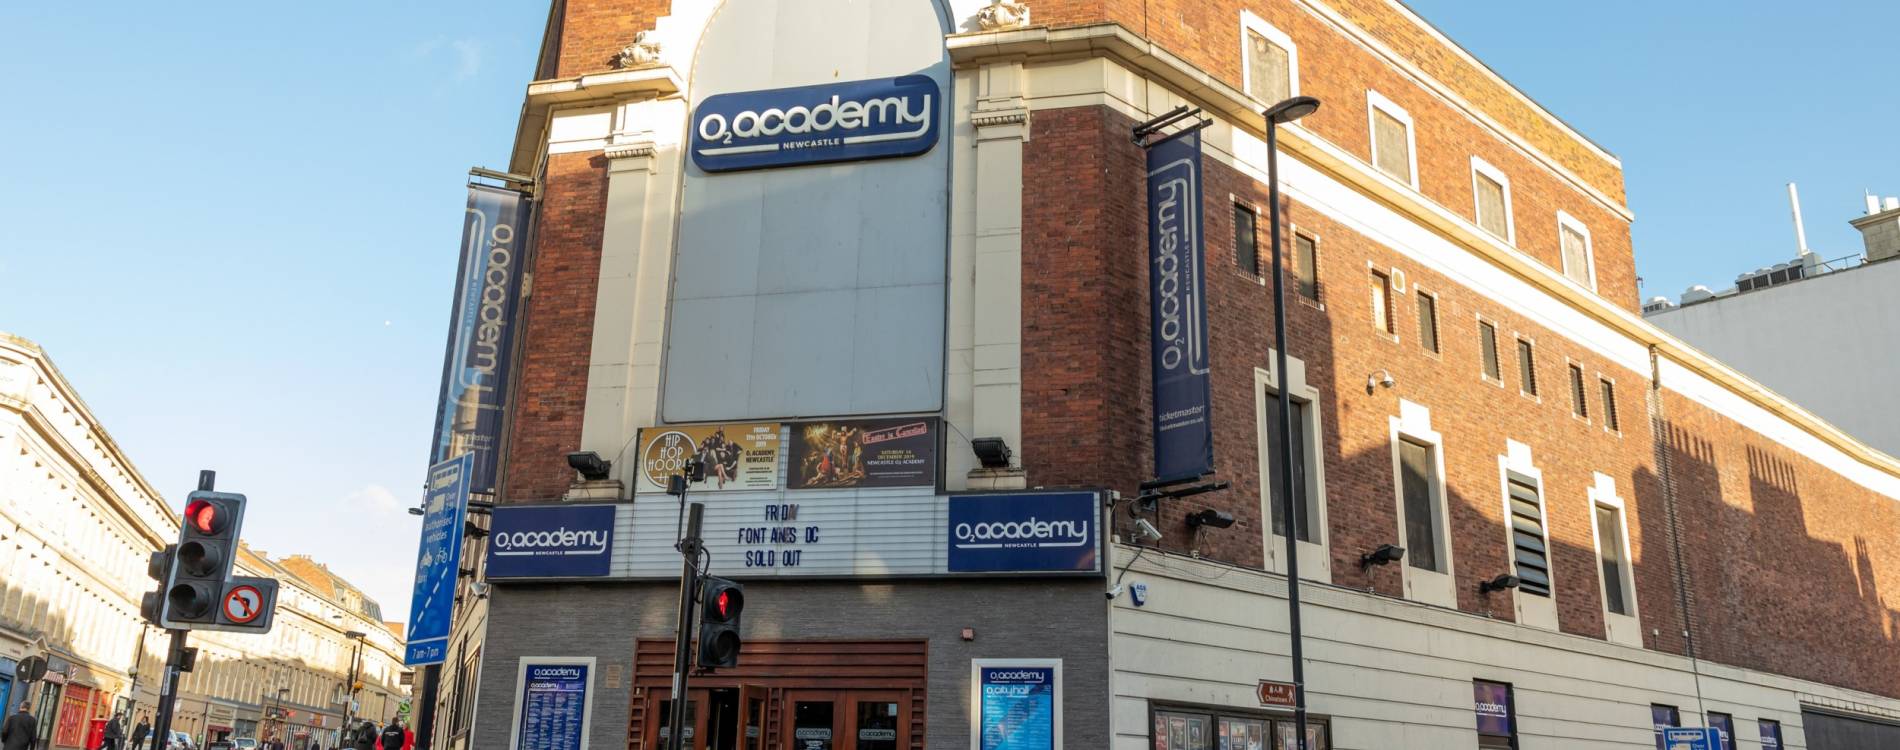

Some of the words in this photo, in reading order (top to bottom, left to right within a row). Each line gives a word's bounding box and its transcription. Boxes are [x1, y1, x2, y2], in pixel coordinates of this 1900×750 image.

[783, 138, 840, 150] NEWCASTLE
[1159, 405, 1204, 421] ticketmaster
[665, 435, 681, 447] HIP
[660, 447, 684, 459] HOP
[805, 526, 819, 543] DC
[745, 550, 775, 567] SOLD
[782, 549, 802, 567] OUT
